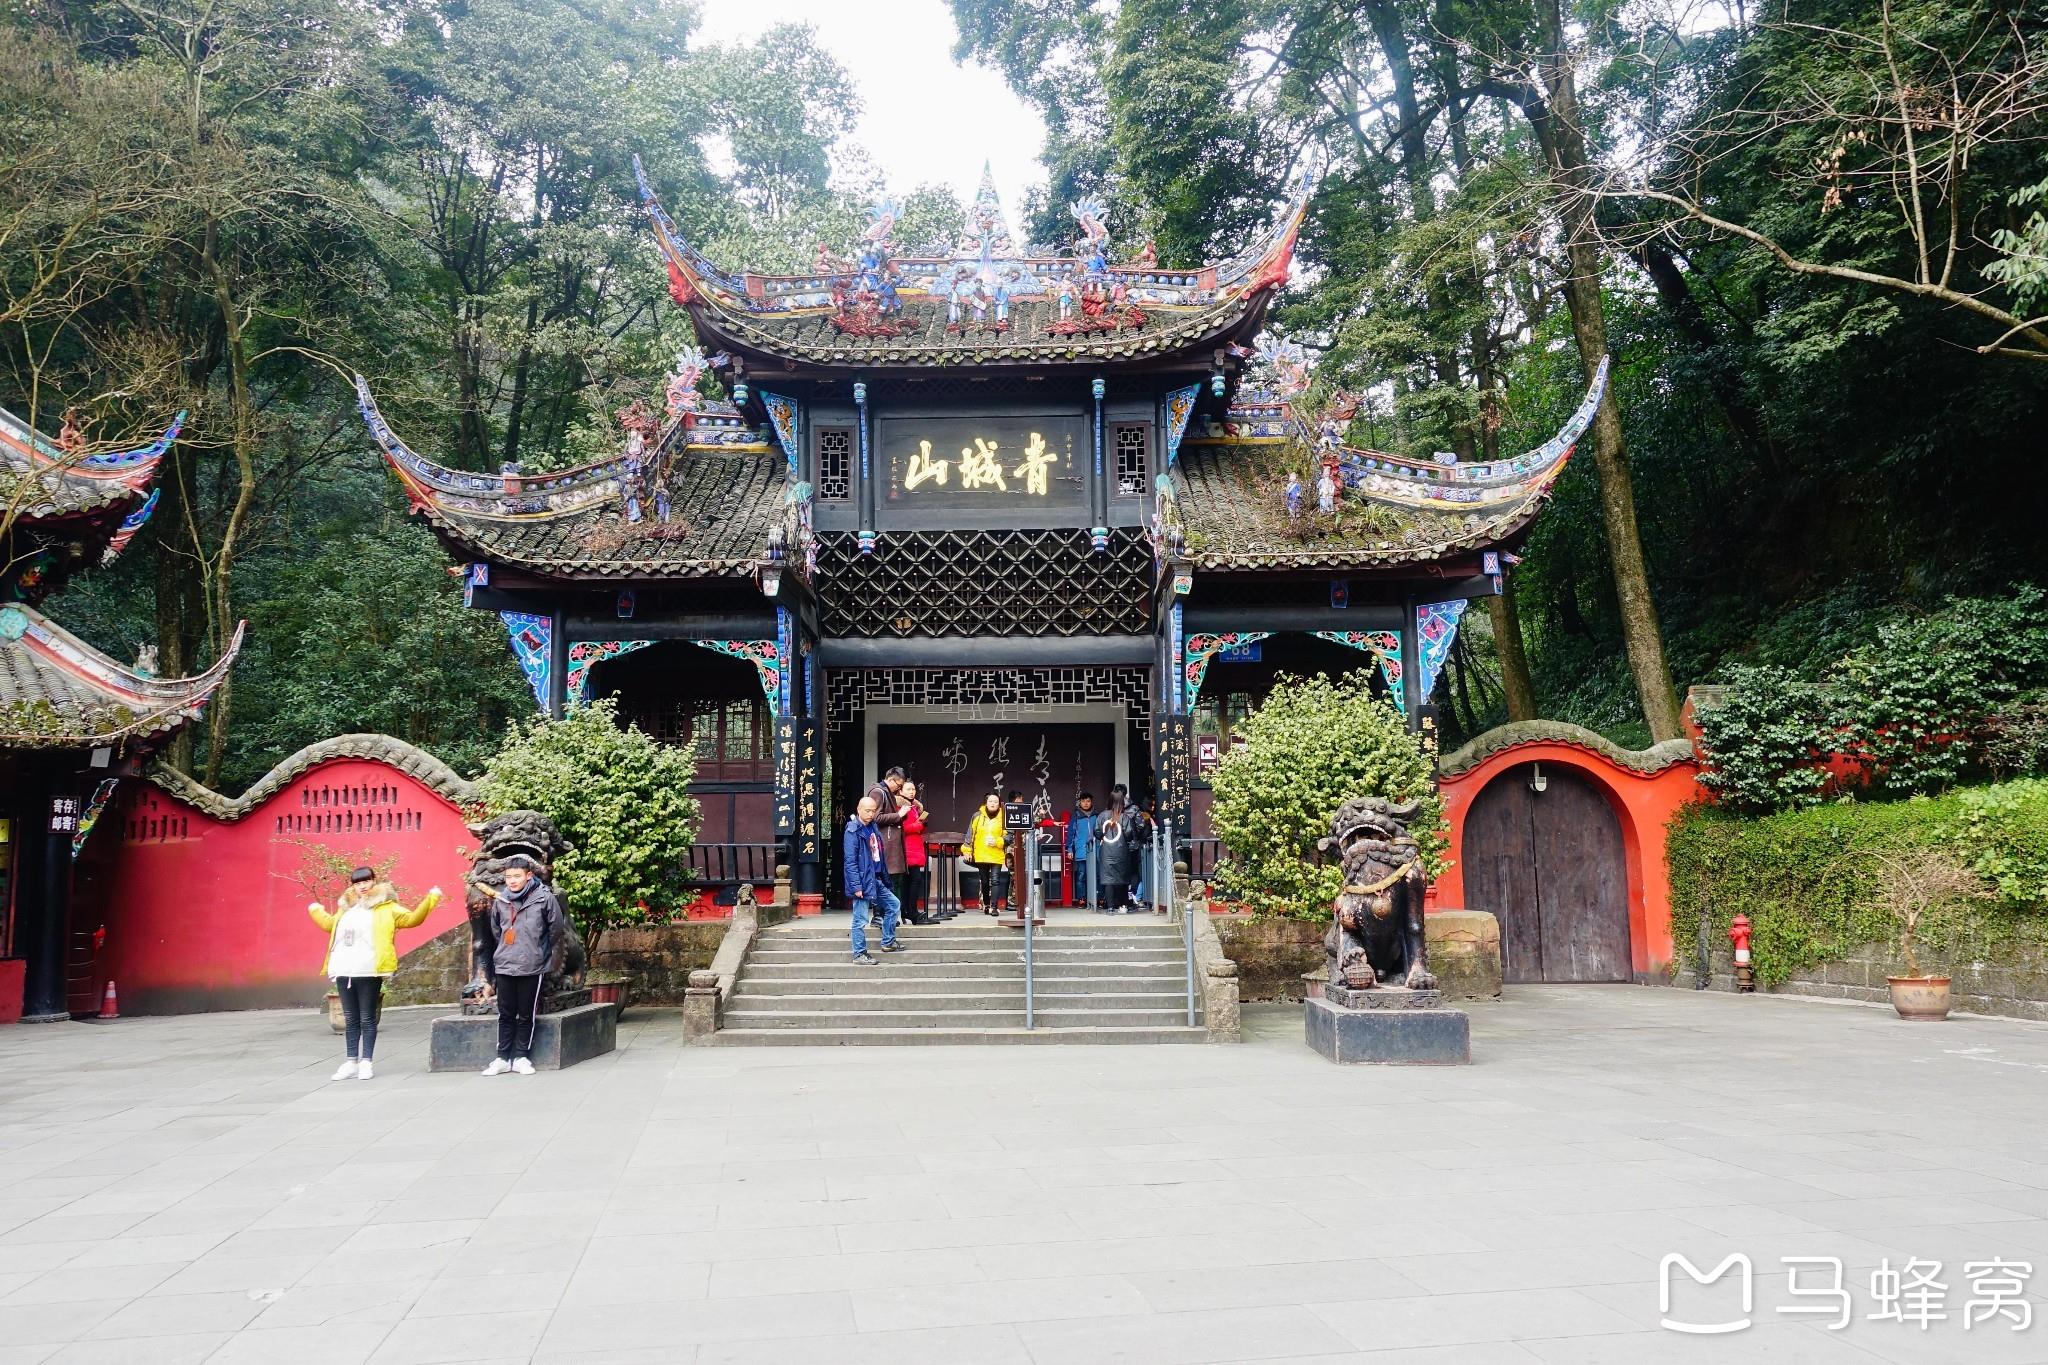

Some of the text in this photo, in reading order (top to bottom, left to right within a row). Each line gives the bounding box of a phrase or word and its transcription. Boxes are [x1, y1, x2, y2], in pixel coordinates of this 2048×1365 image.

[905, 432, 1058, 495] 青城山
[53, 798, 73, 814] 寄存
[51, 815, 72, 831] 邮寄
